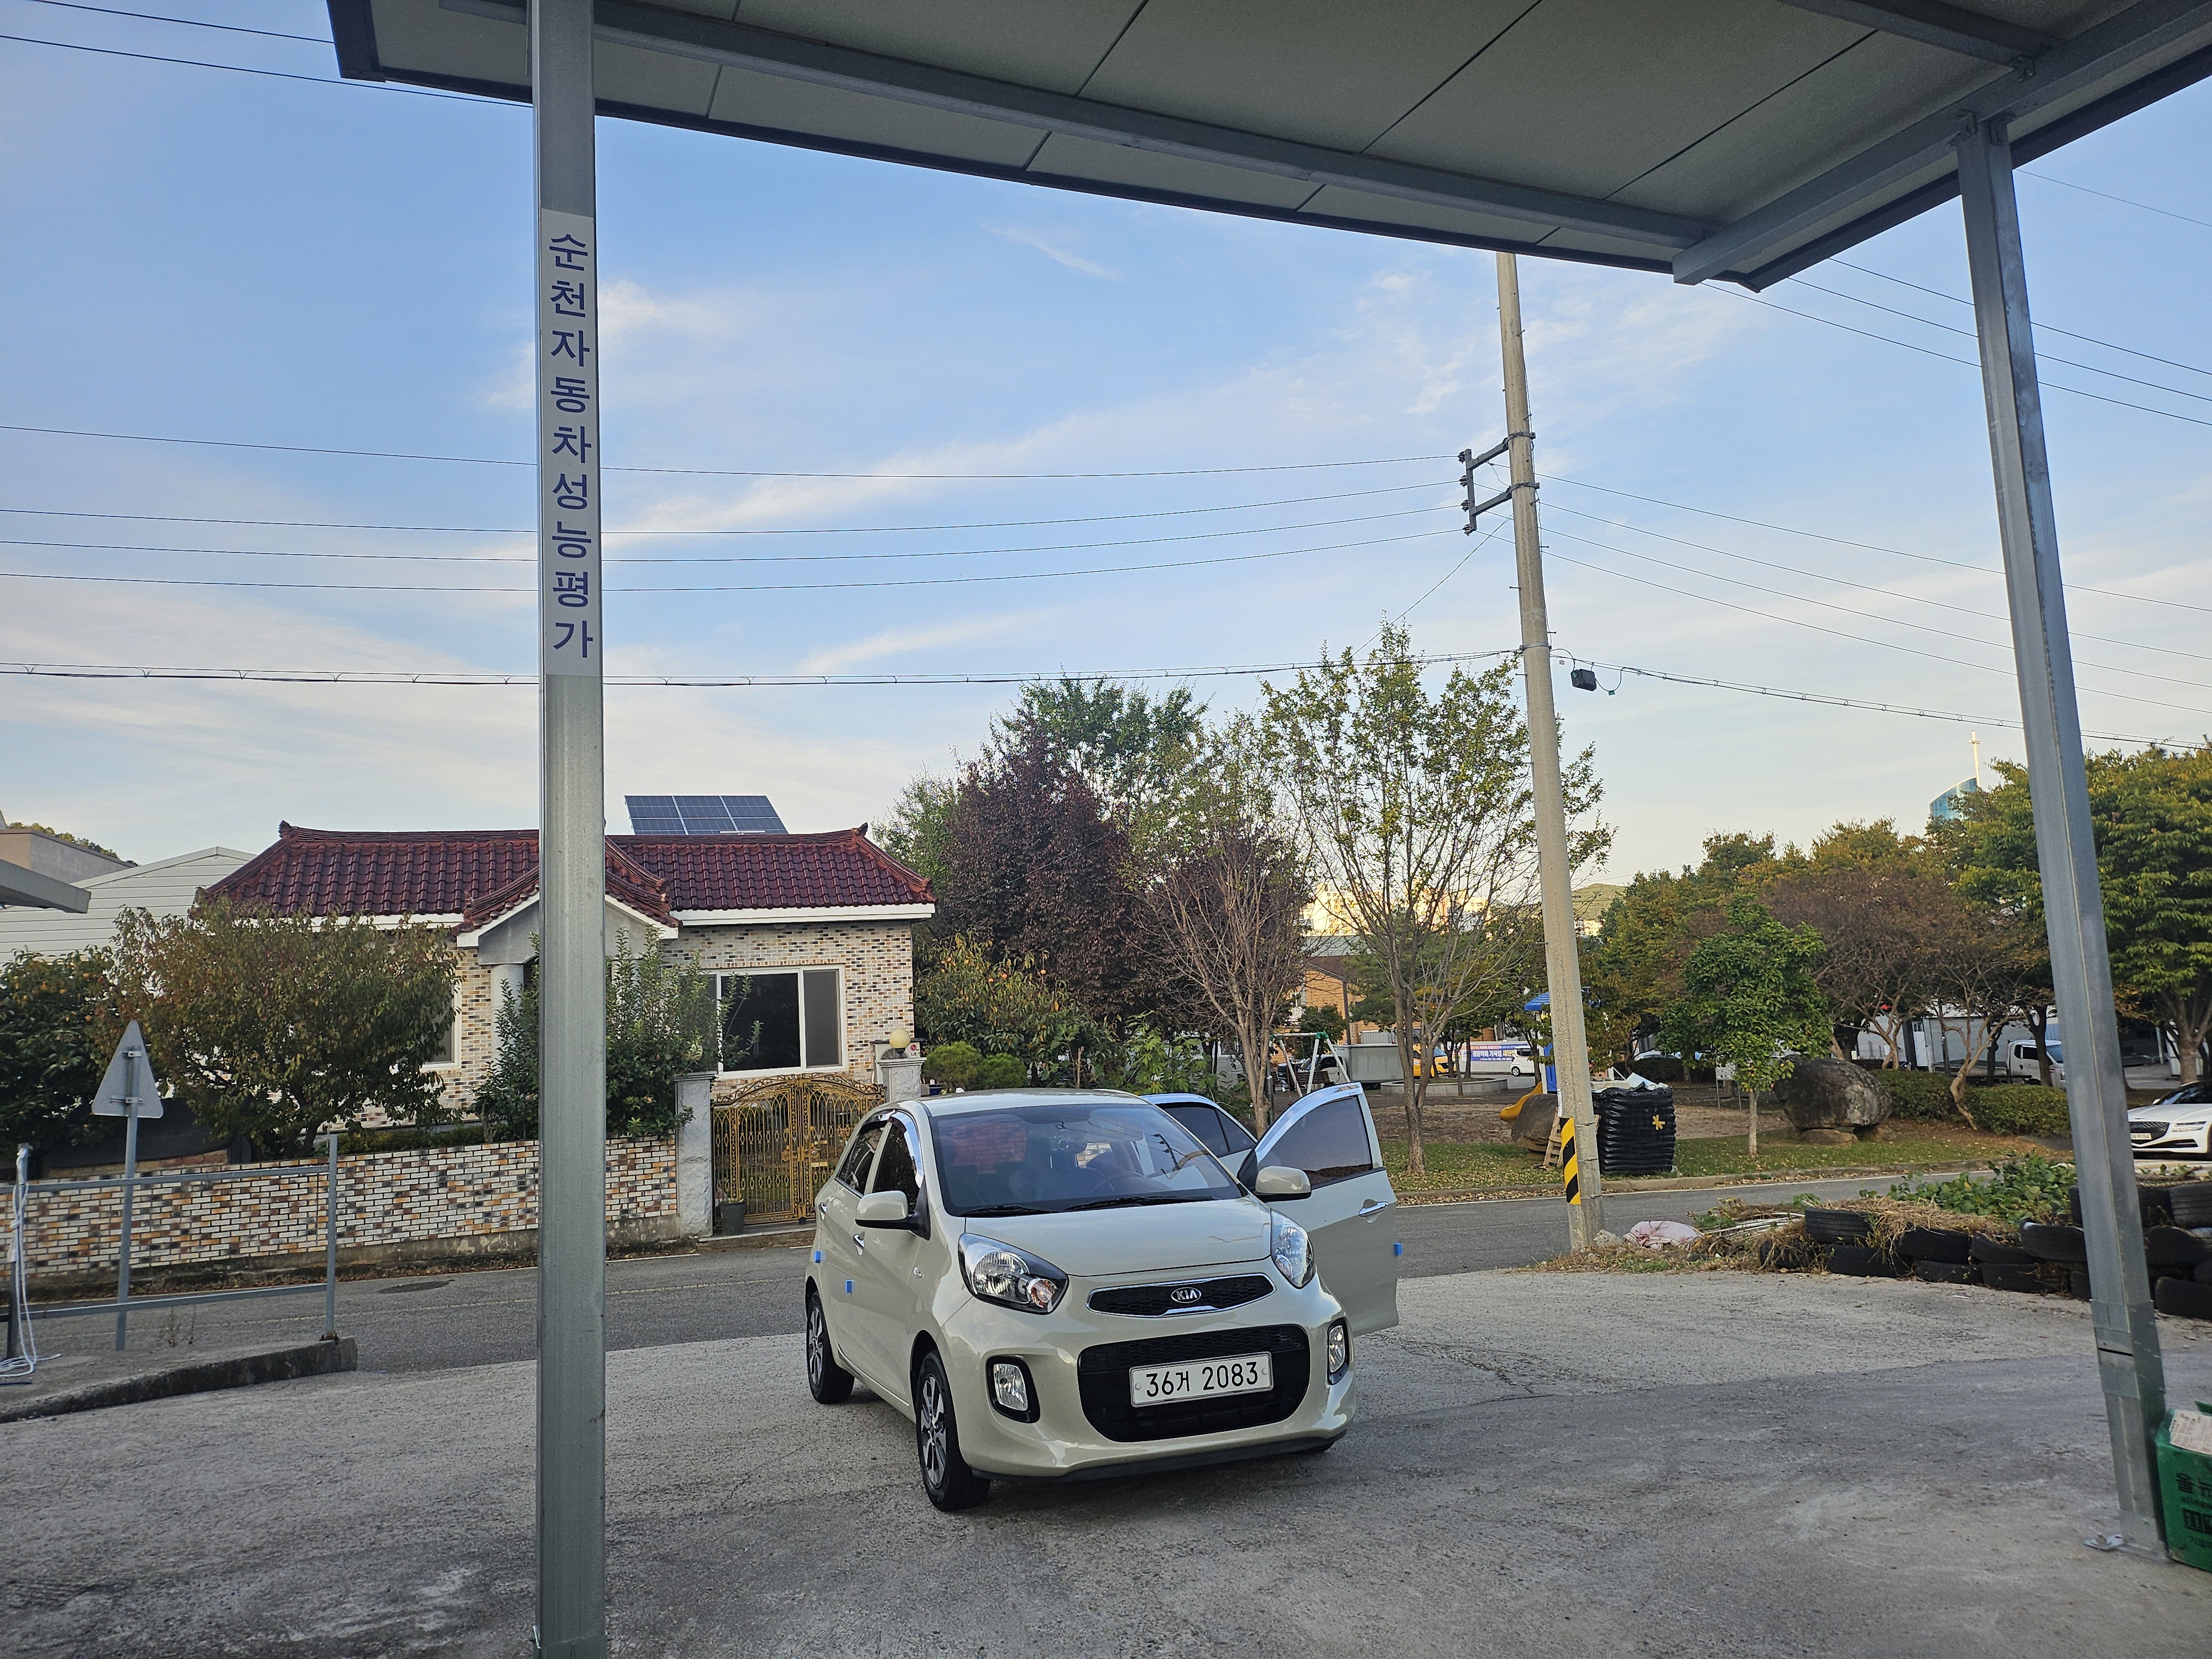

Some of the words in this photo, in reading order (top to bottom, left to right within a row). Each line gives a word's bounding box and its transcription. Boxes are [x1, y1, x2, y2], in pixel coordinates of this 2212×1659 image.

[549, 234, 593, 658] 순천자동차성능평가
[1176, 1289, 1198, 1300] KIA
[1146, 1370, 1190, 1397] 36거
[1202, 1361, 1258, 1391] 2083
